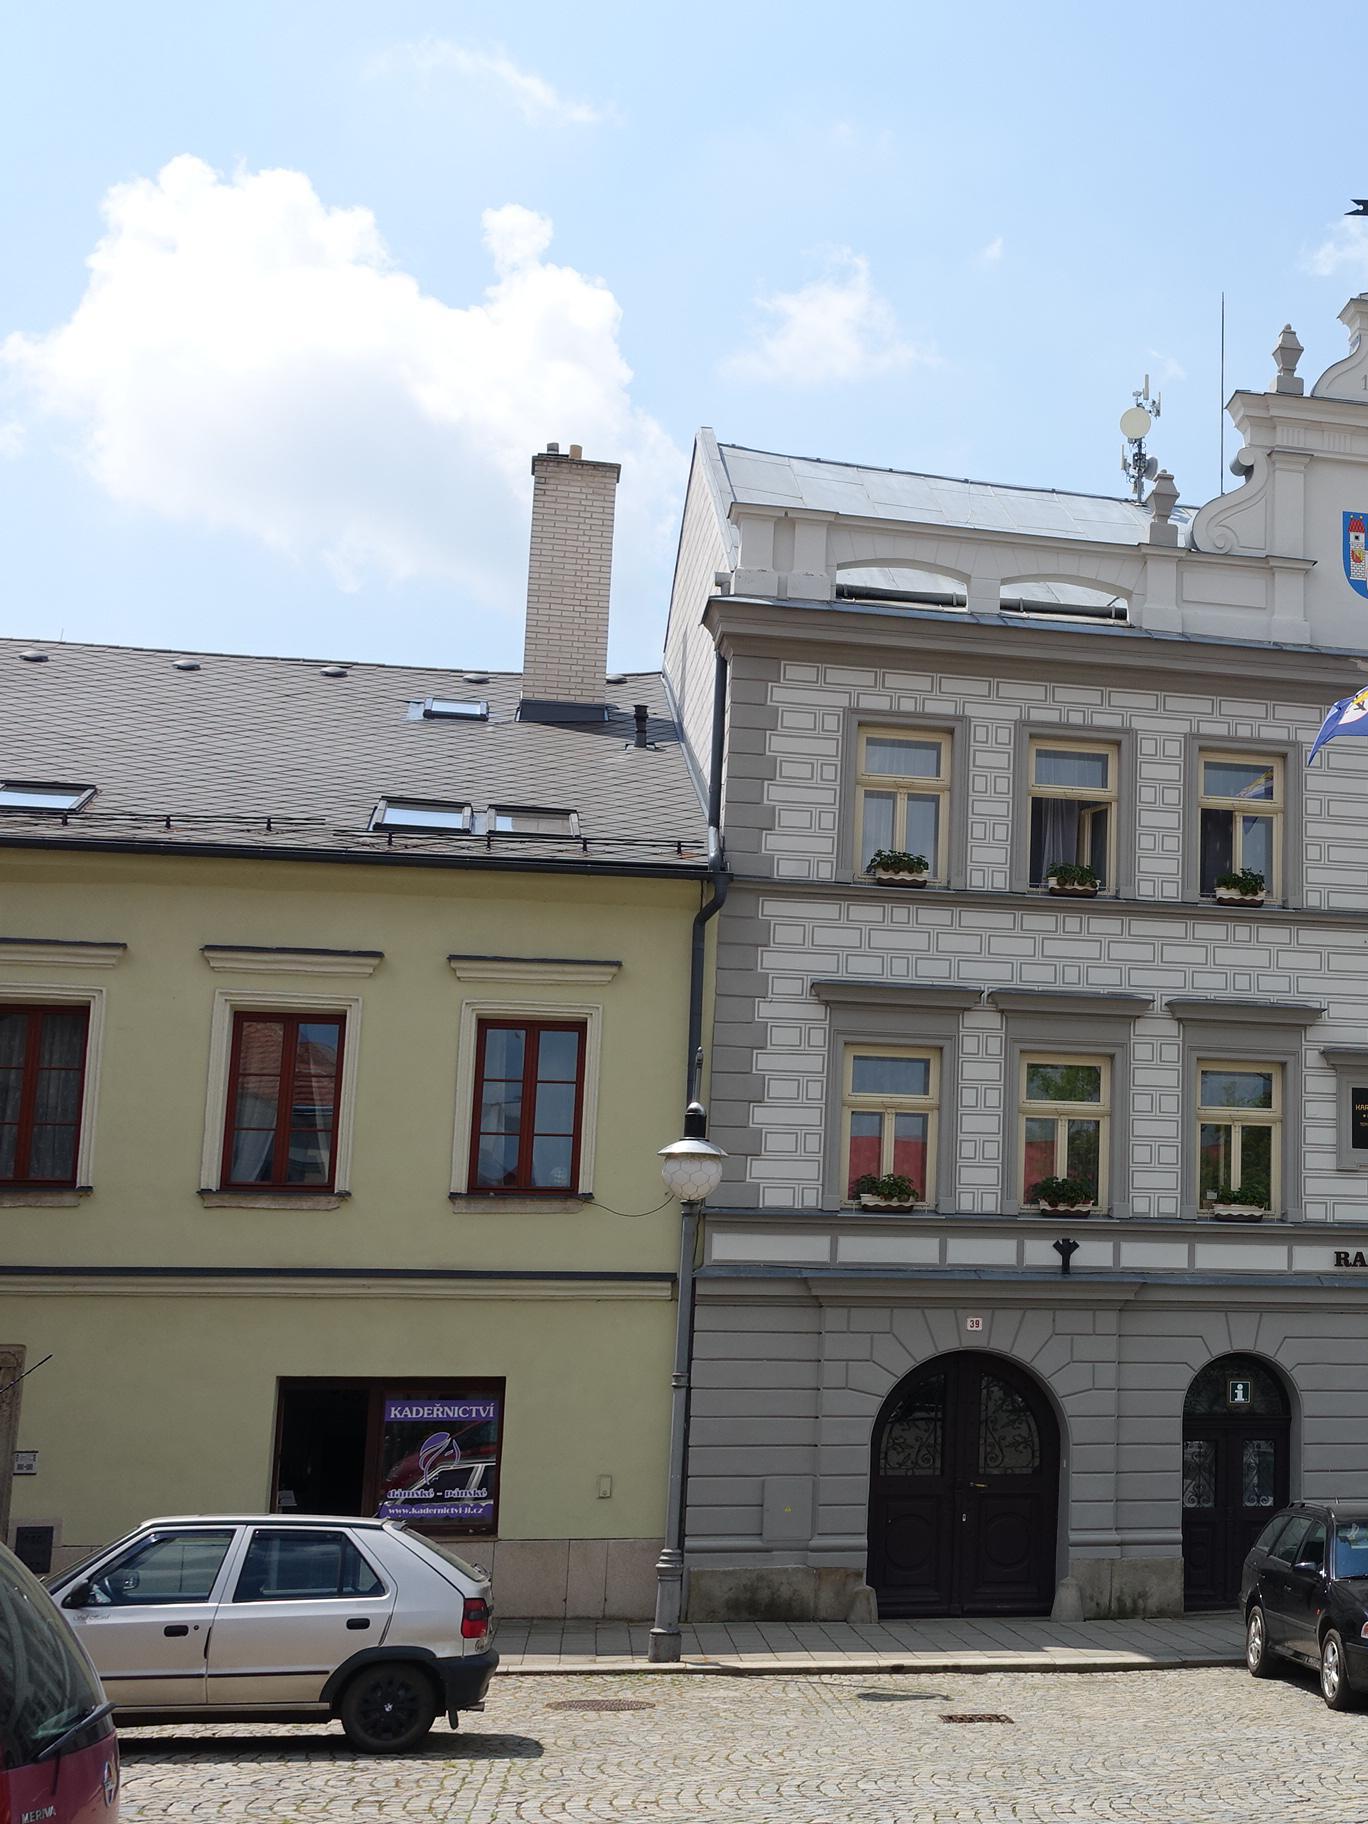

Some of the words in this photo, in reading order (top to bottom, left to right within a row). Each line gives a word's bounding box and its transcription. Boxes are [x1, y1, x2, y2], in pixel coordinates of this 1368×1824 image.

[970, 1319, 980, 1329] 39
[390, 1403, 495, 1419] KADEŘNICTVÍ
[386, 1488, 435, 1499] dámské
[444, 1487, 488, 1499] pánské
